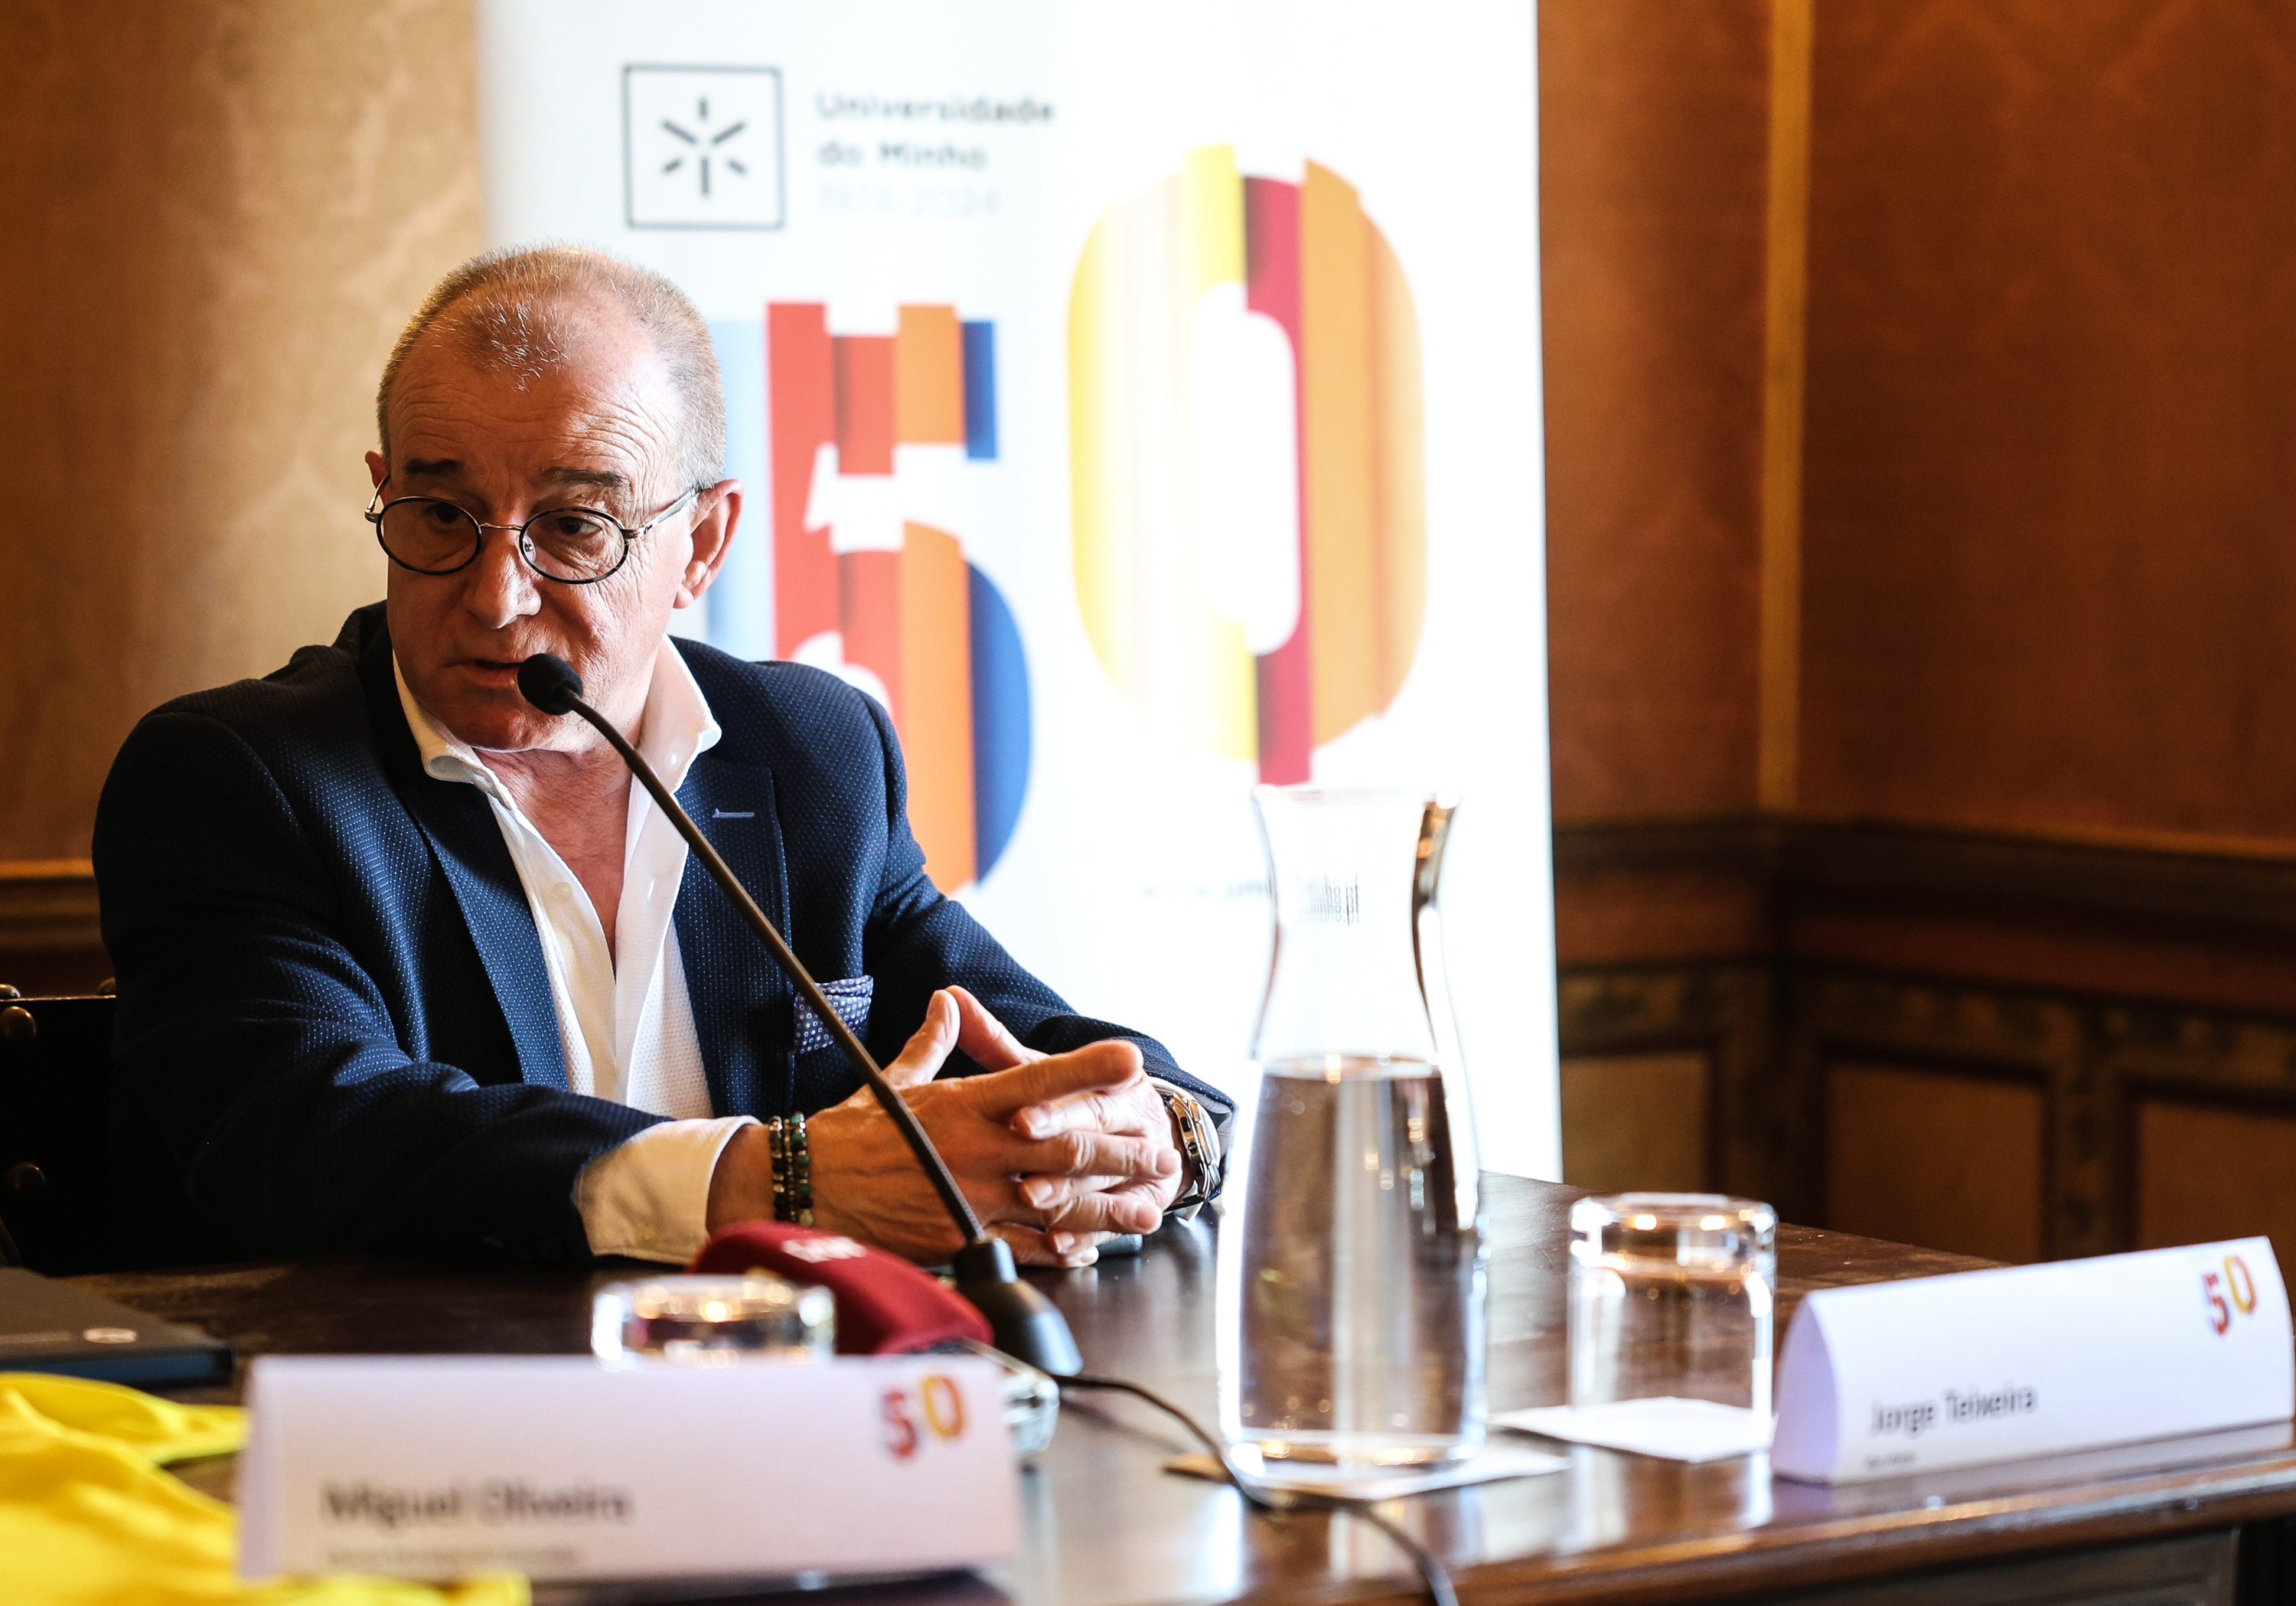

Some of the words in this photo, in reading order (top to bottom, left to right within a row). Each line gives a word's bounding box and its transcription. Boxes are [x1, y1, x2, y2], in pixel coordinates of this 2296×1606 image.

[815, 90, 1055, 122] Universidade
[816, 139, 864, 167] do
[878, 139, 989, 171] Minho
[2203, 1255, 2256, 1335] 50
[881, 1375, 965, 1457] 50
[1870, 1400, 1937, 1438] Jorge
[1942, 1380, 2038, 1424] Teixeira
[321, 1482, 458, 1535] Miguel
[481, 1479, 634, 1525] Oliveira
